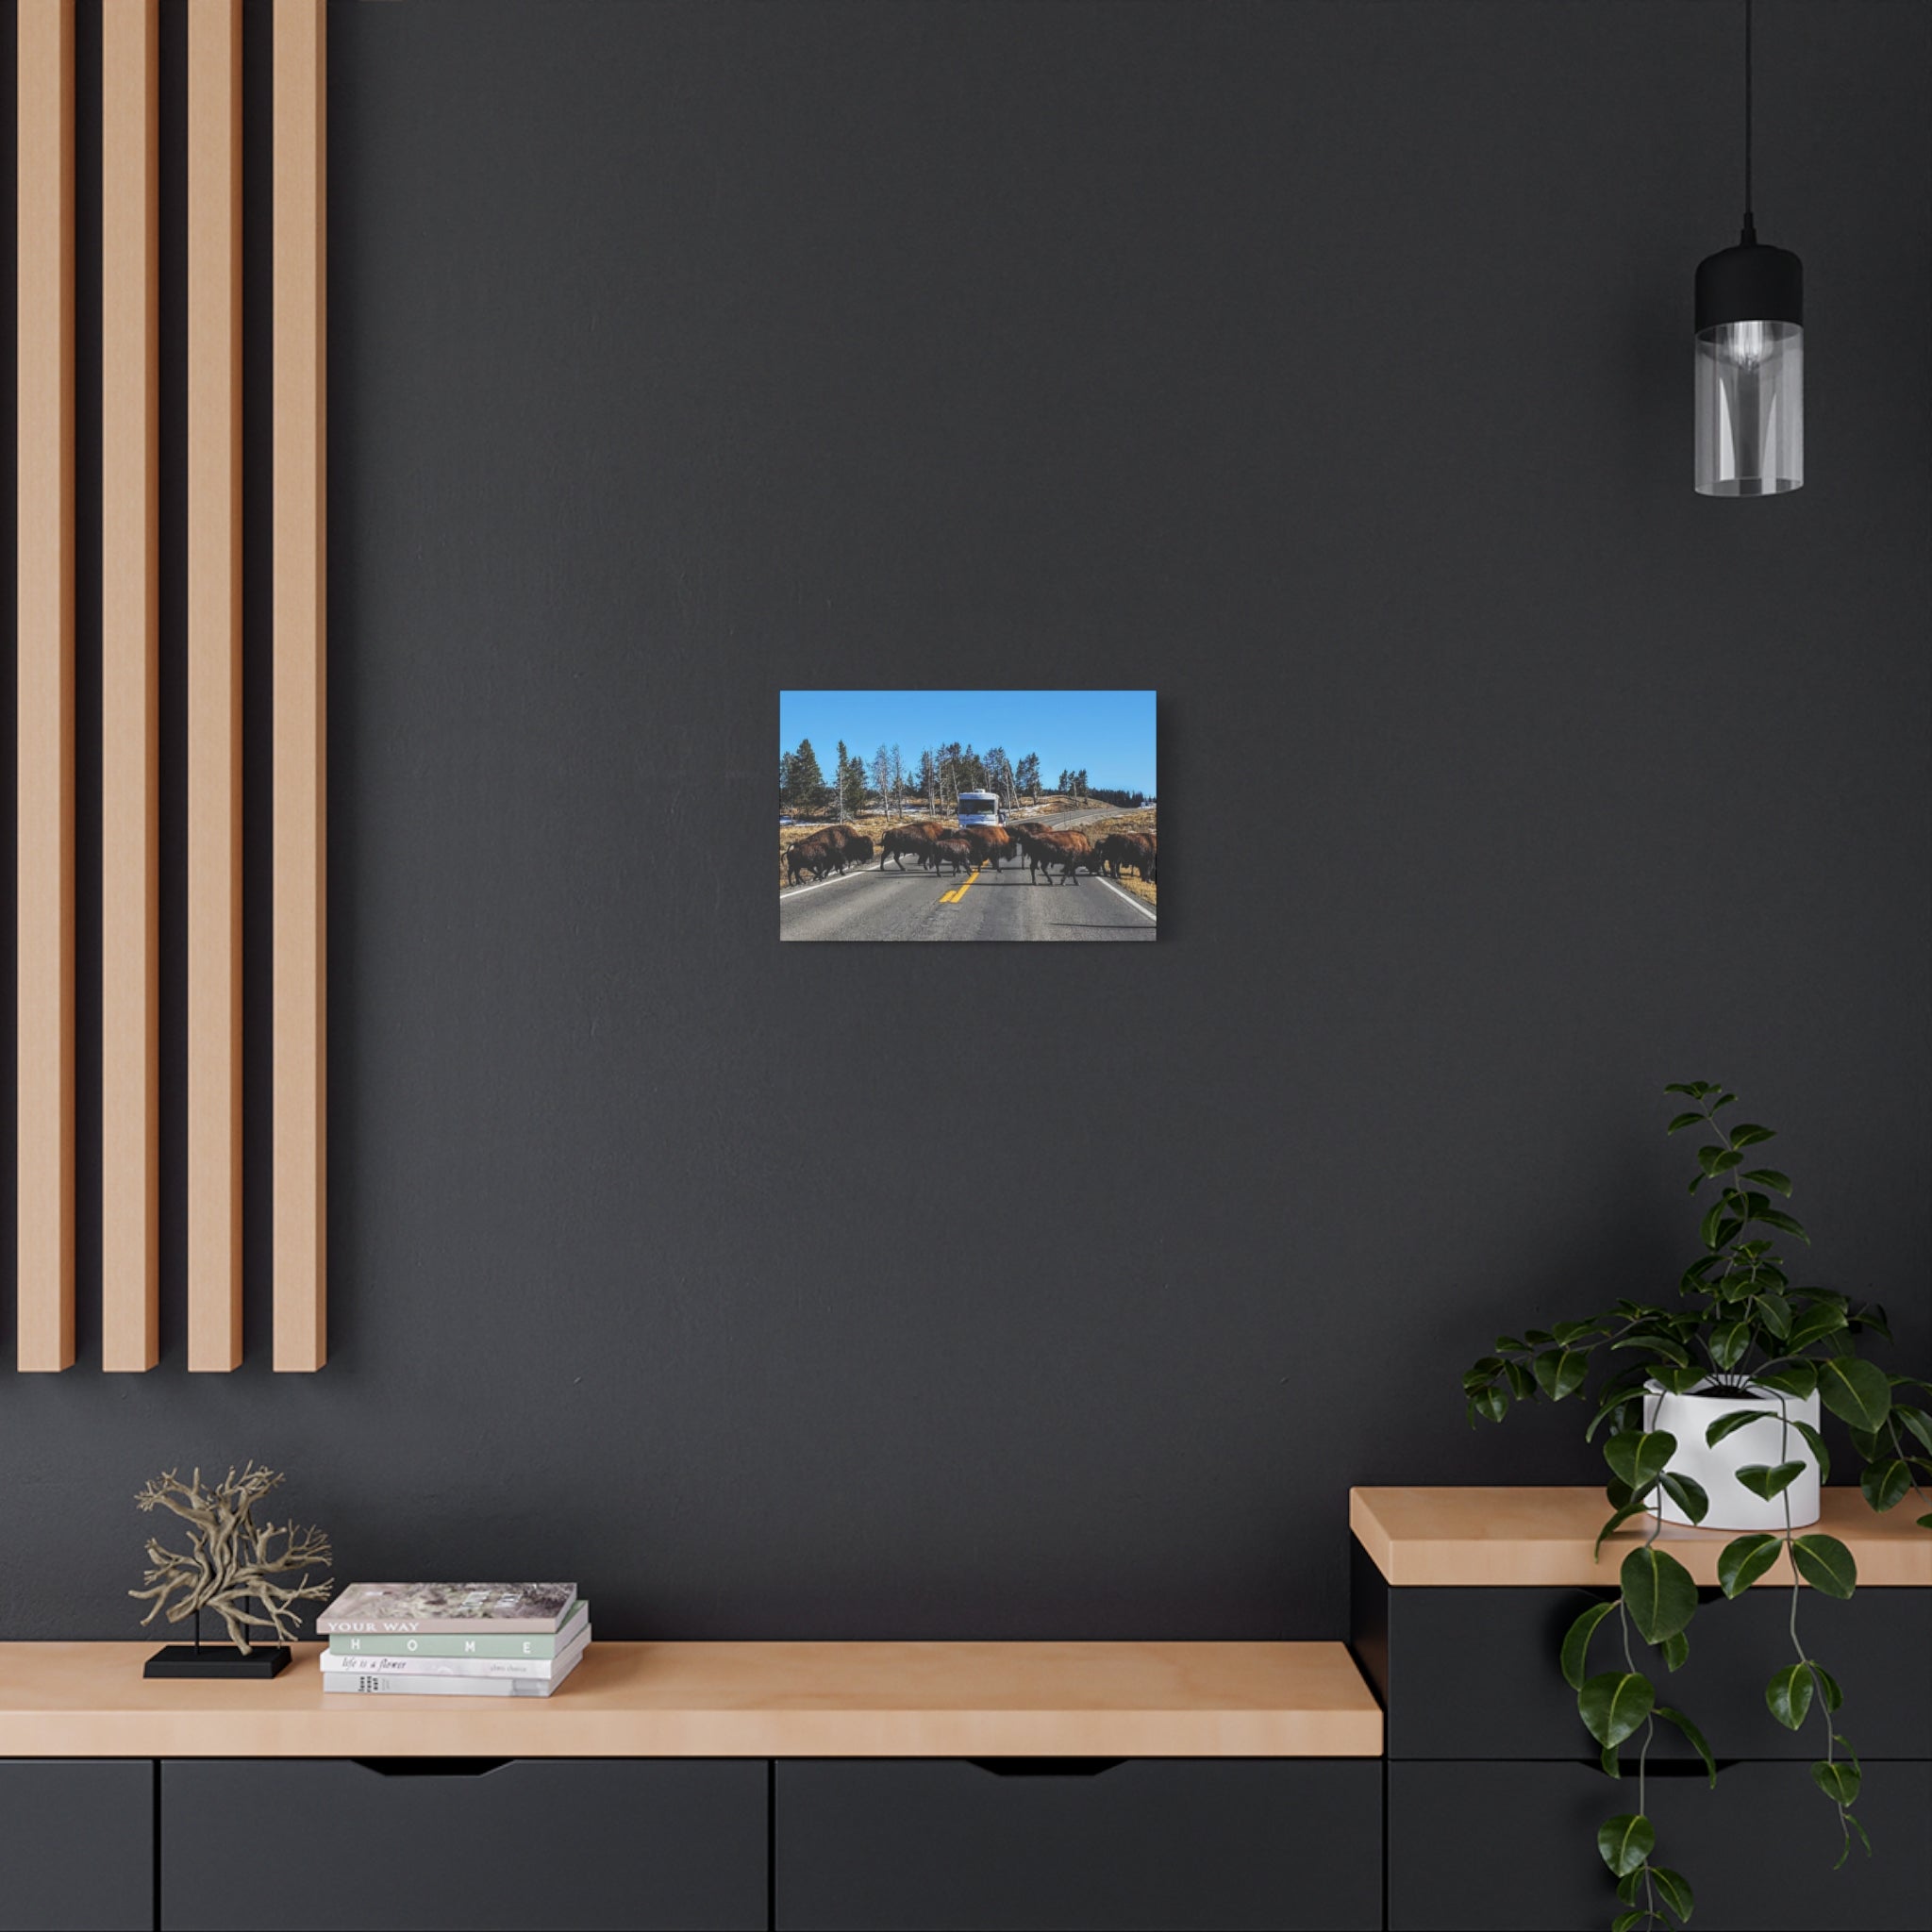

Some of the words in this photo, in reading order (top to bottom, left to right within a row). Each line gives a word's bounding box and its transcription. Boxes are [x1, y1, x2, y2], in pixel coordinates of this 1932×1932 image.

[327, 1622, 377, 1632] YOUR
[383, 1622, 420, 1632] WAY
[377, 1658, 407, 1672] flower
